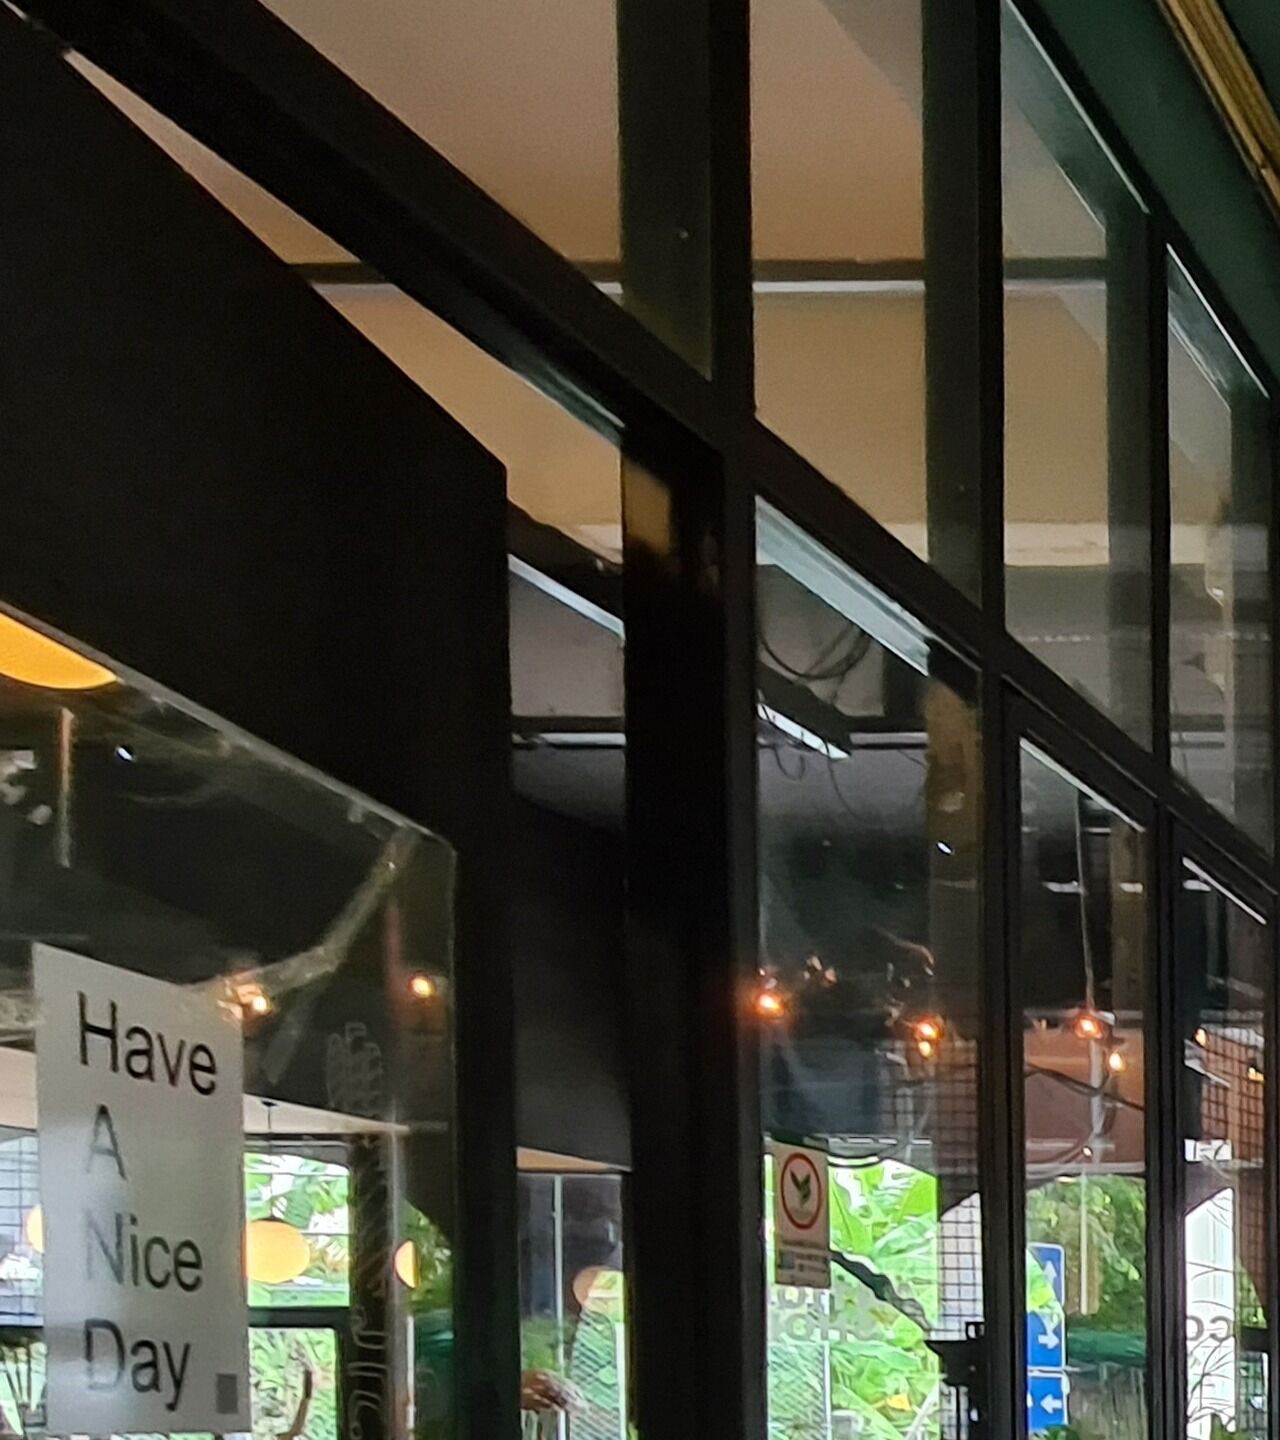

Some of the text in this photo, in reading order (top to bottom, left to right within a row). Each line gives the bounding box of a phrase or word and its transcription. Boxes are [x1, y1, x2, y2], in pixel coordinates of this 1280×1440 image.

[77, 991, 218, 1096] Have
[89, 1104, 127, 1182] A
[86, 1208, 203, 1293] Nice
[83, 1319, 192, 1412] Day
